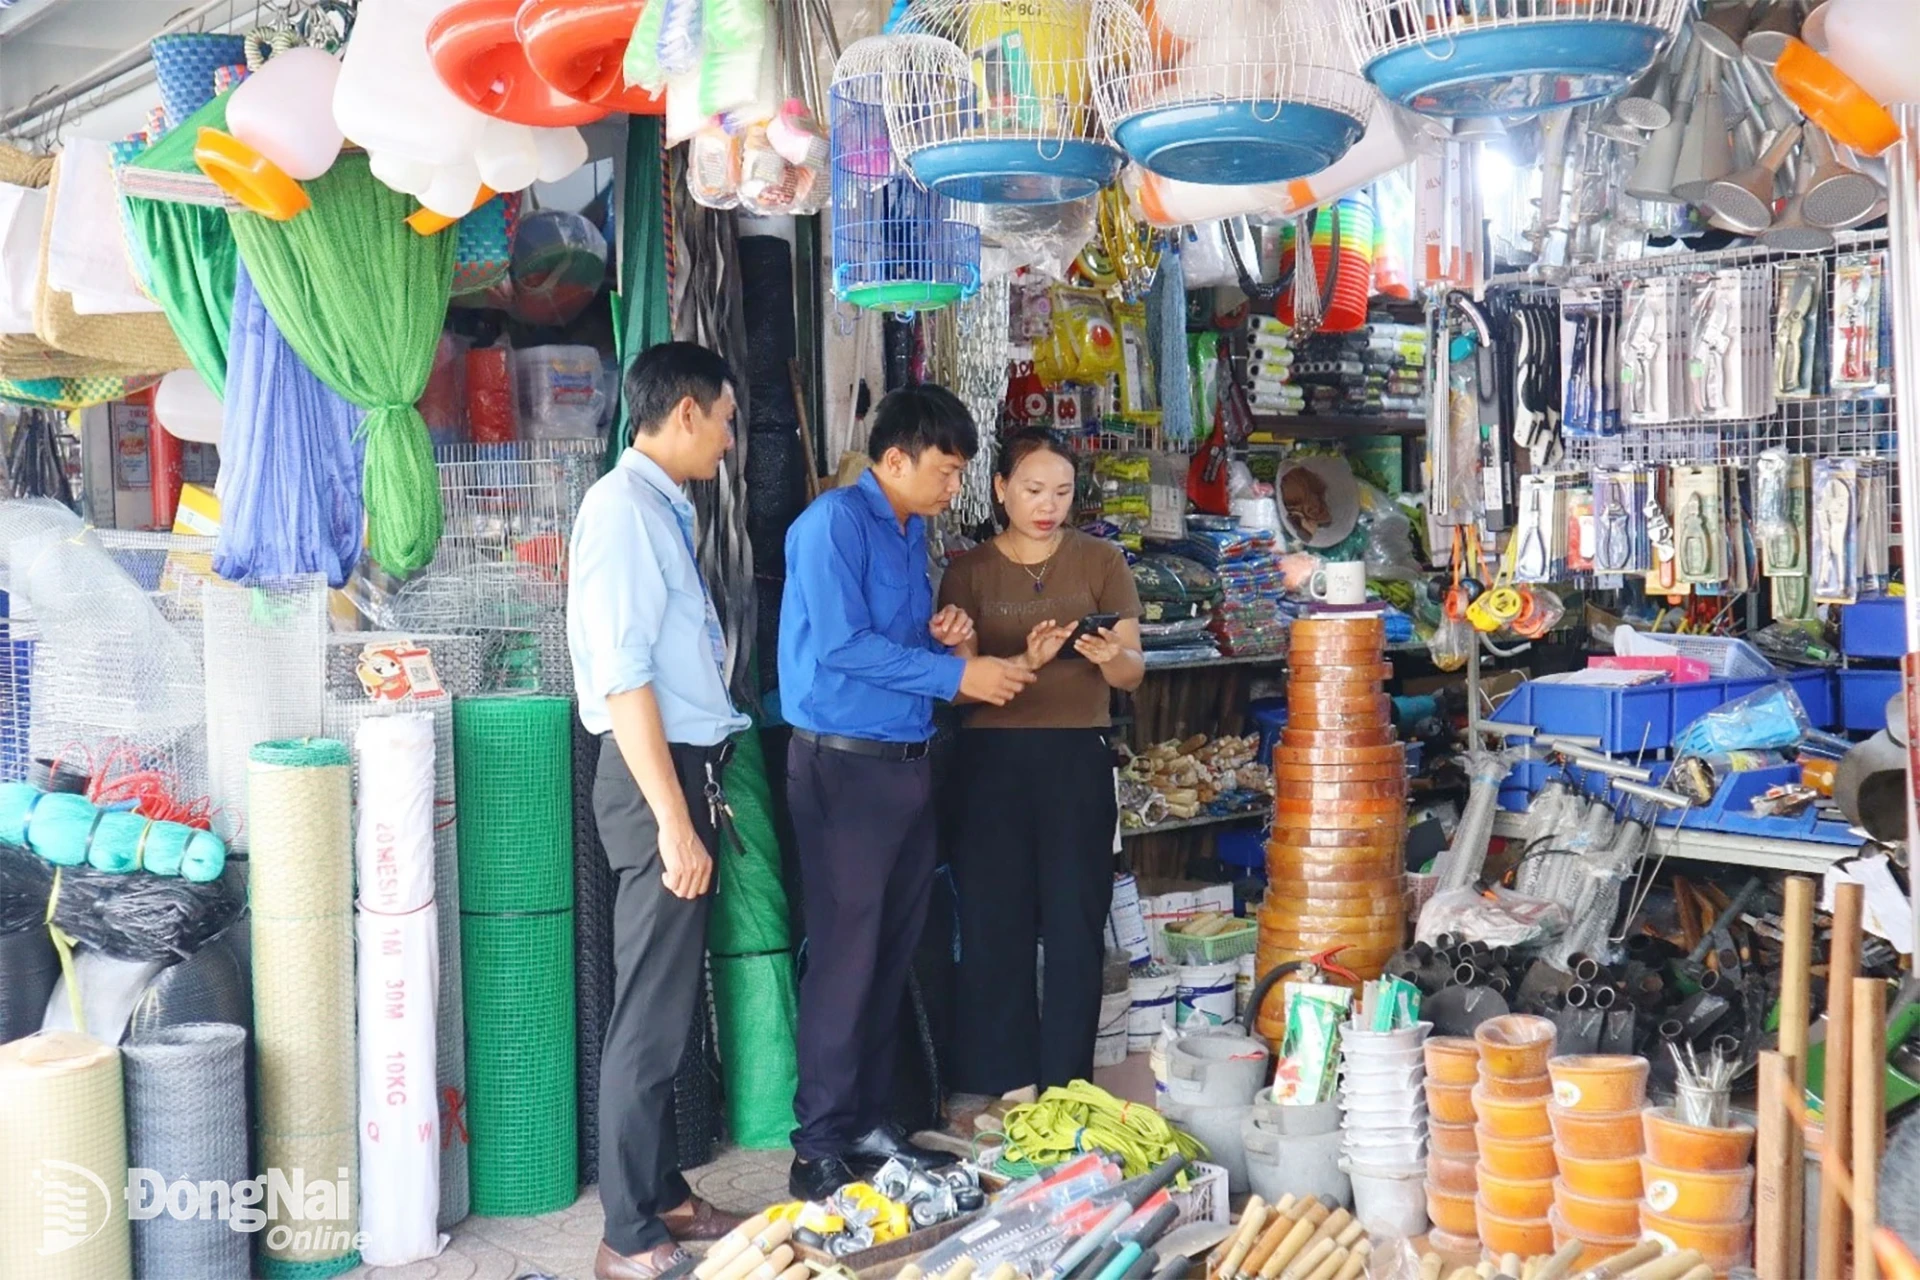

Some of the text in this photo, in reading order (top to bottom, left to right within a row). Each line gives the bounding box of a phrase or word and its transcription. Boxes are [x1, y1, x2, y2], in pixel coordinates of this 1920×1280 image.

[381, 929, 402, 956] 1M
[385, 979, 405, 1021] 30M
[386, 1051, 407, 1107] 10KG
[418, 1121, 433, 1143] W
